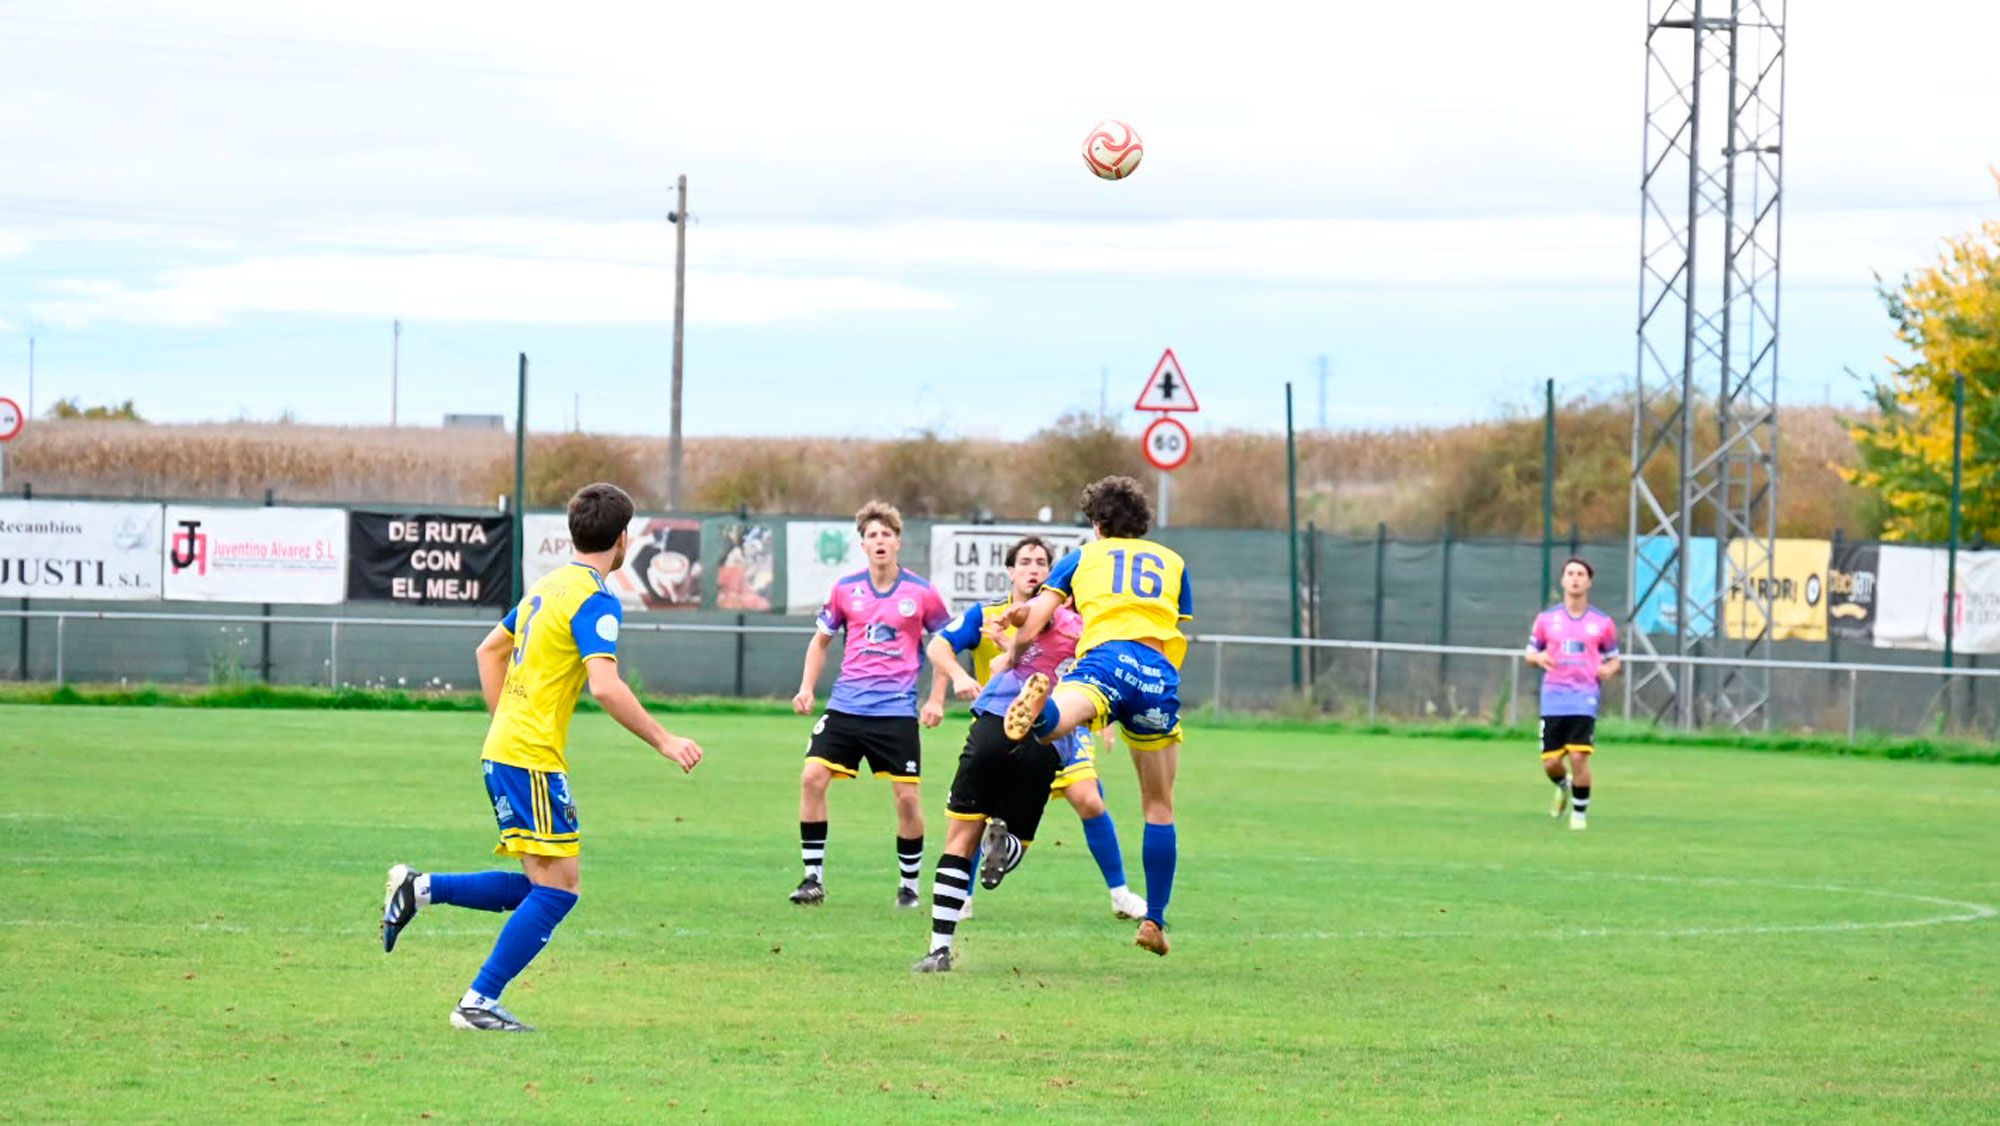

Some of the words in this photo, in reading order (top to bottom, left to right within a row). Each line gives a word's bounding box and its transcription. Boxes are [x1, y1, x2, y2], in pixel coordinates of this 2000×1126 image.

[1154, 433, 1181, 451] 60
[388, 521, 419, 542] DE
[425, 521, 487, 544] RUTA
[213, 539, 268, 558] Juventino
[410, 549, 462, 571] CON
[954, 541, 980, 566] LA
[954, 570, 978, 593] DE
[1107, 549, 1165, 599] 16
[391, 577, 422, 598] EL
[426, 578, 480, 600] MEJI
[812, 714, 829, 735] 6
[557, 773, 571, 804] 3
